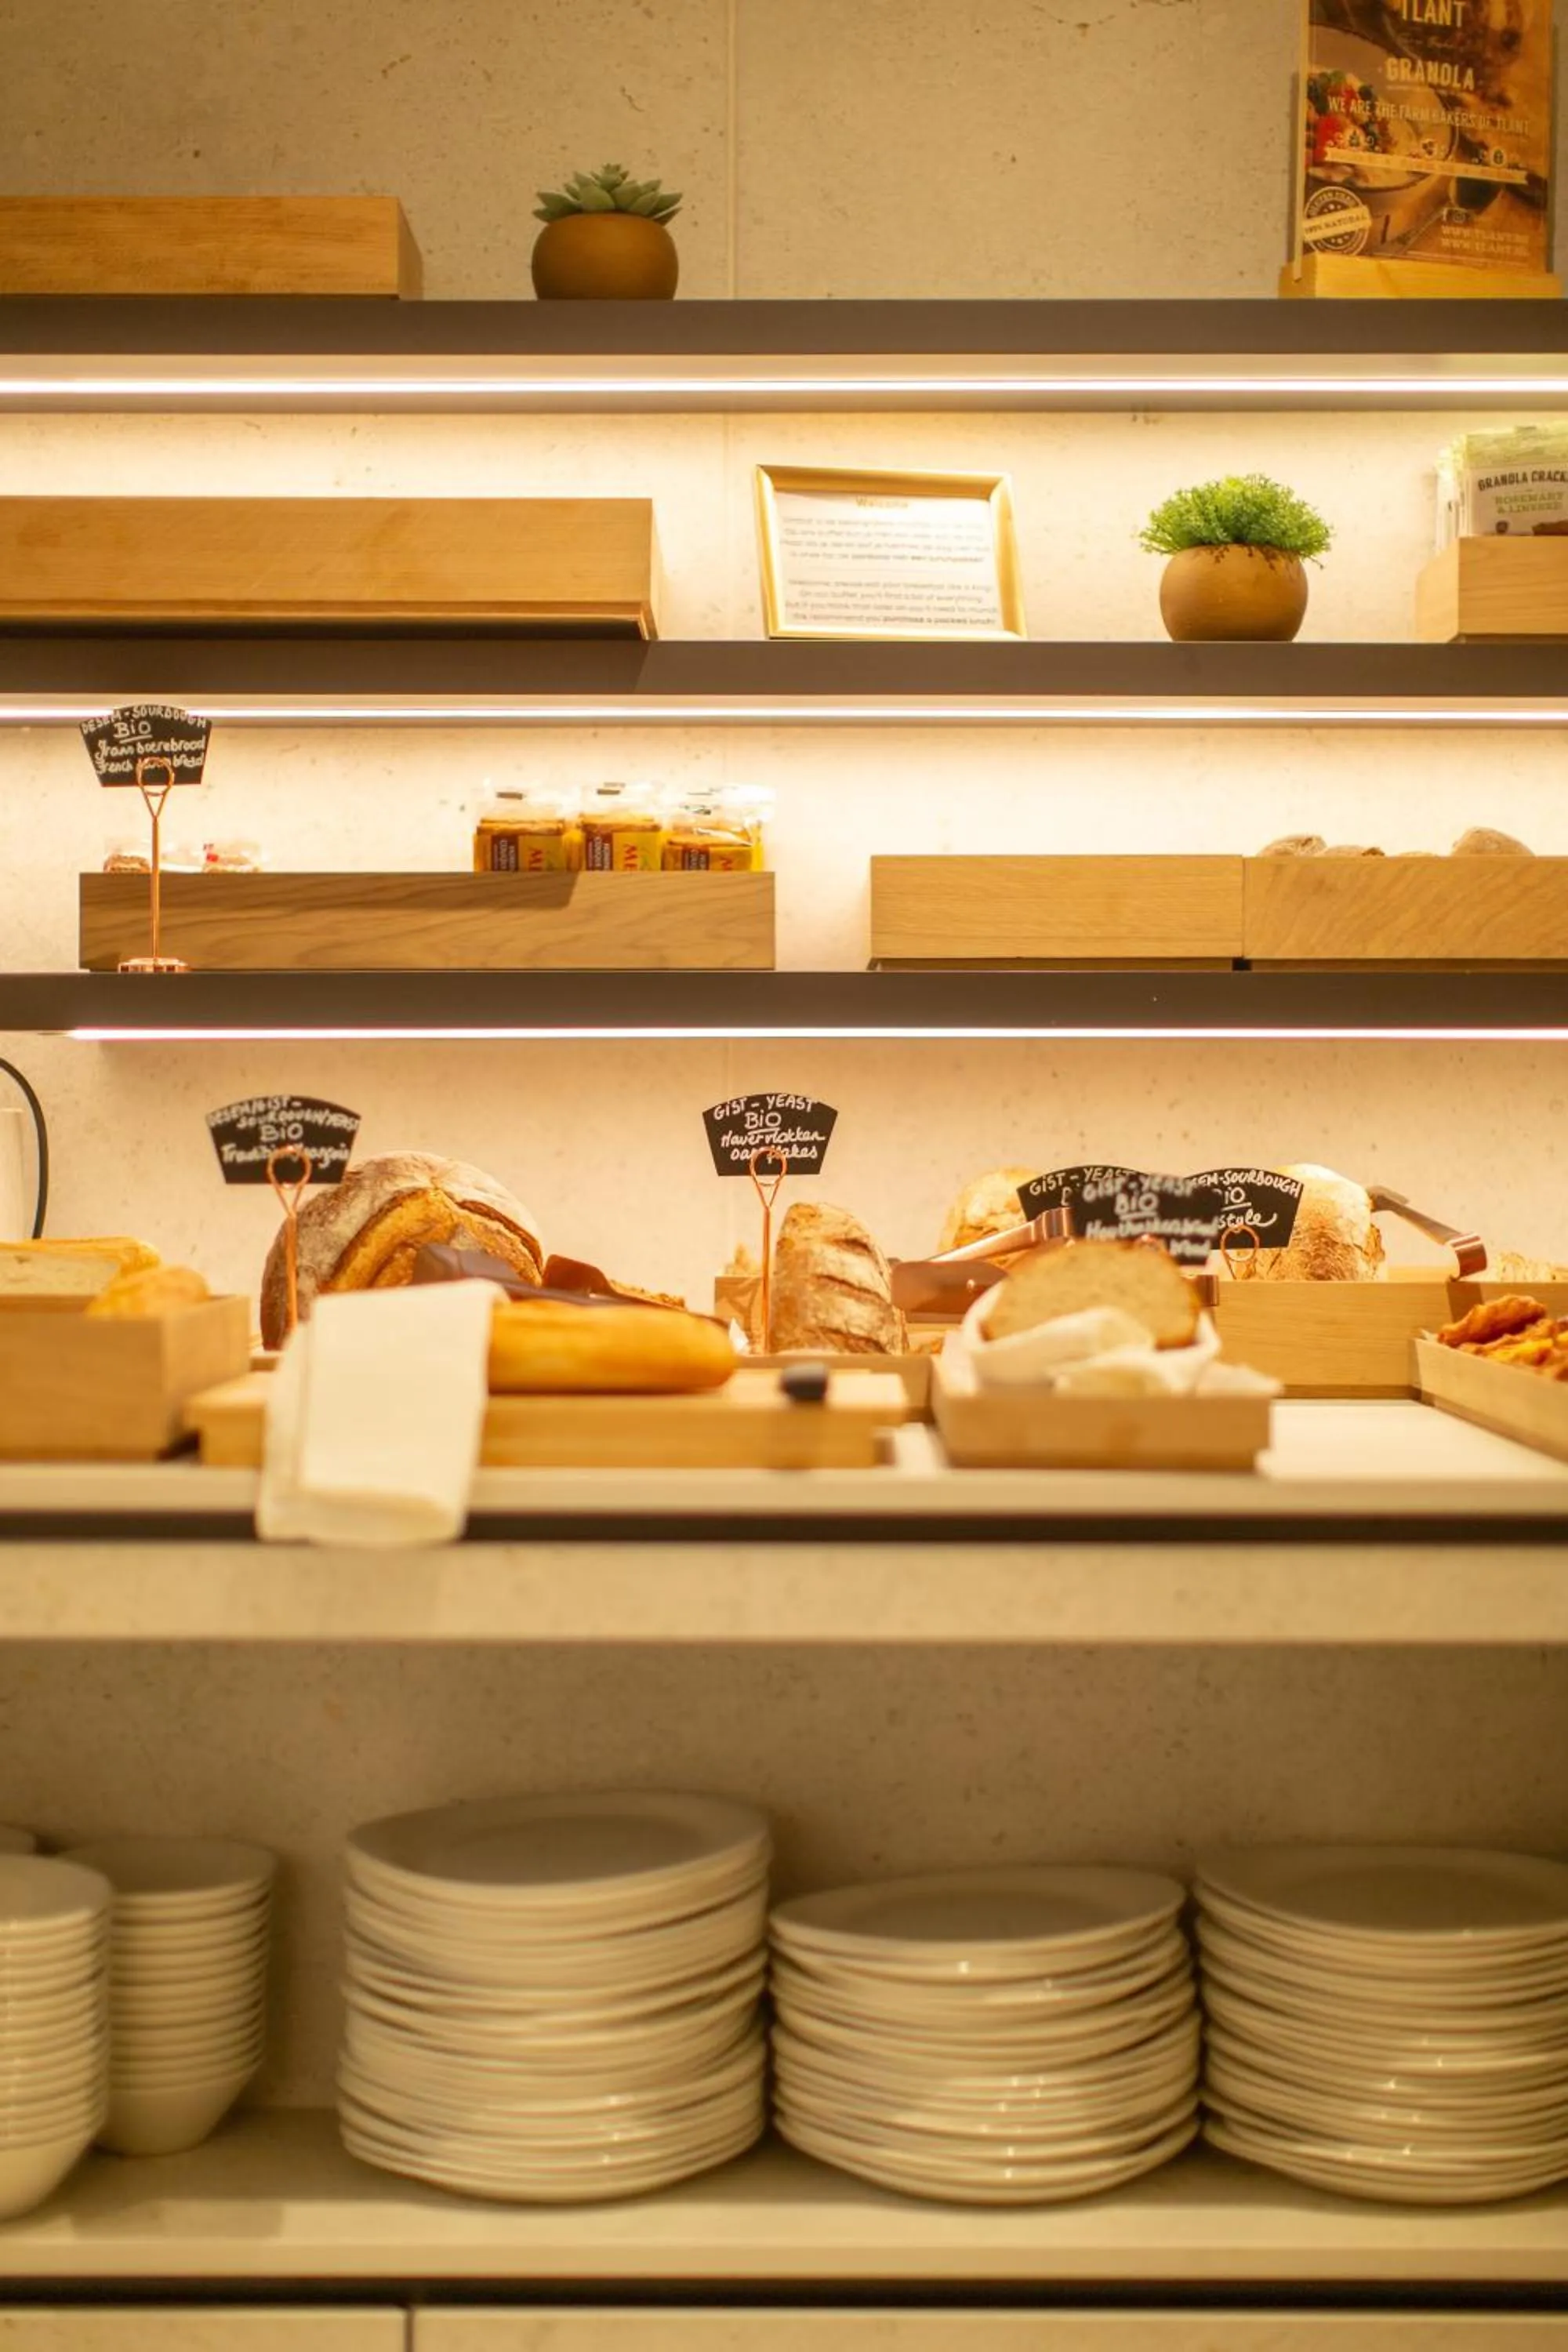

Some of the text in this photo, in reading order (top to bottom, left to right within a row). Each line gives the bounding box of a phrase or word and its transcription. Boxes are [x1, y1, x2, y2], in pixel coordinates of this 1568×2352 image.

[1385, 57, 1474, 90] GRANOLA
[1328, 96, 1346, 114] WE
[1349, 100, 1371, 116] ARE
[1374, 102, 1396, 118] THE
[1478, 471, 1528, 492] GRANOLA
[765, 1094, 815, 1112] YEAST
